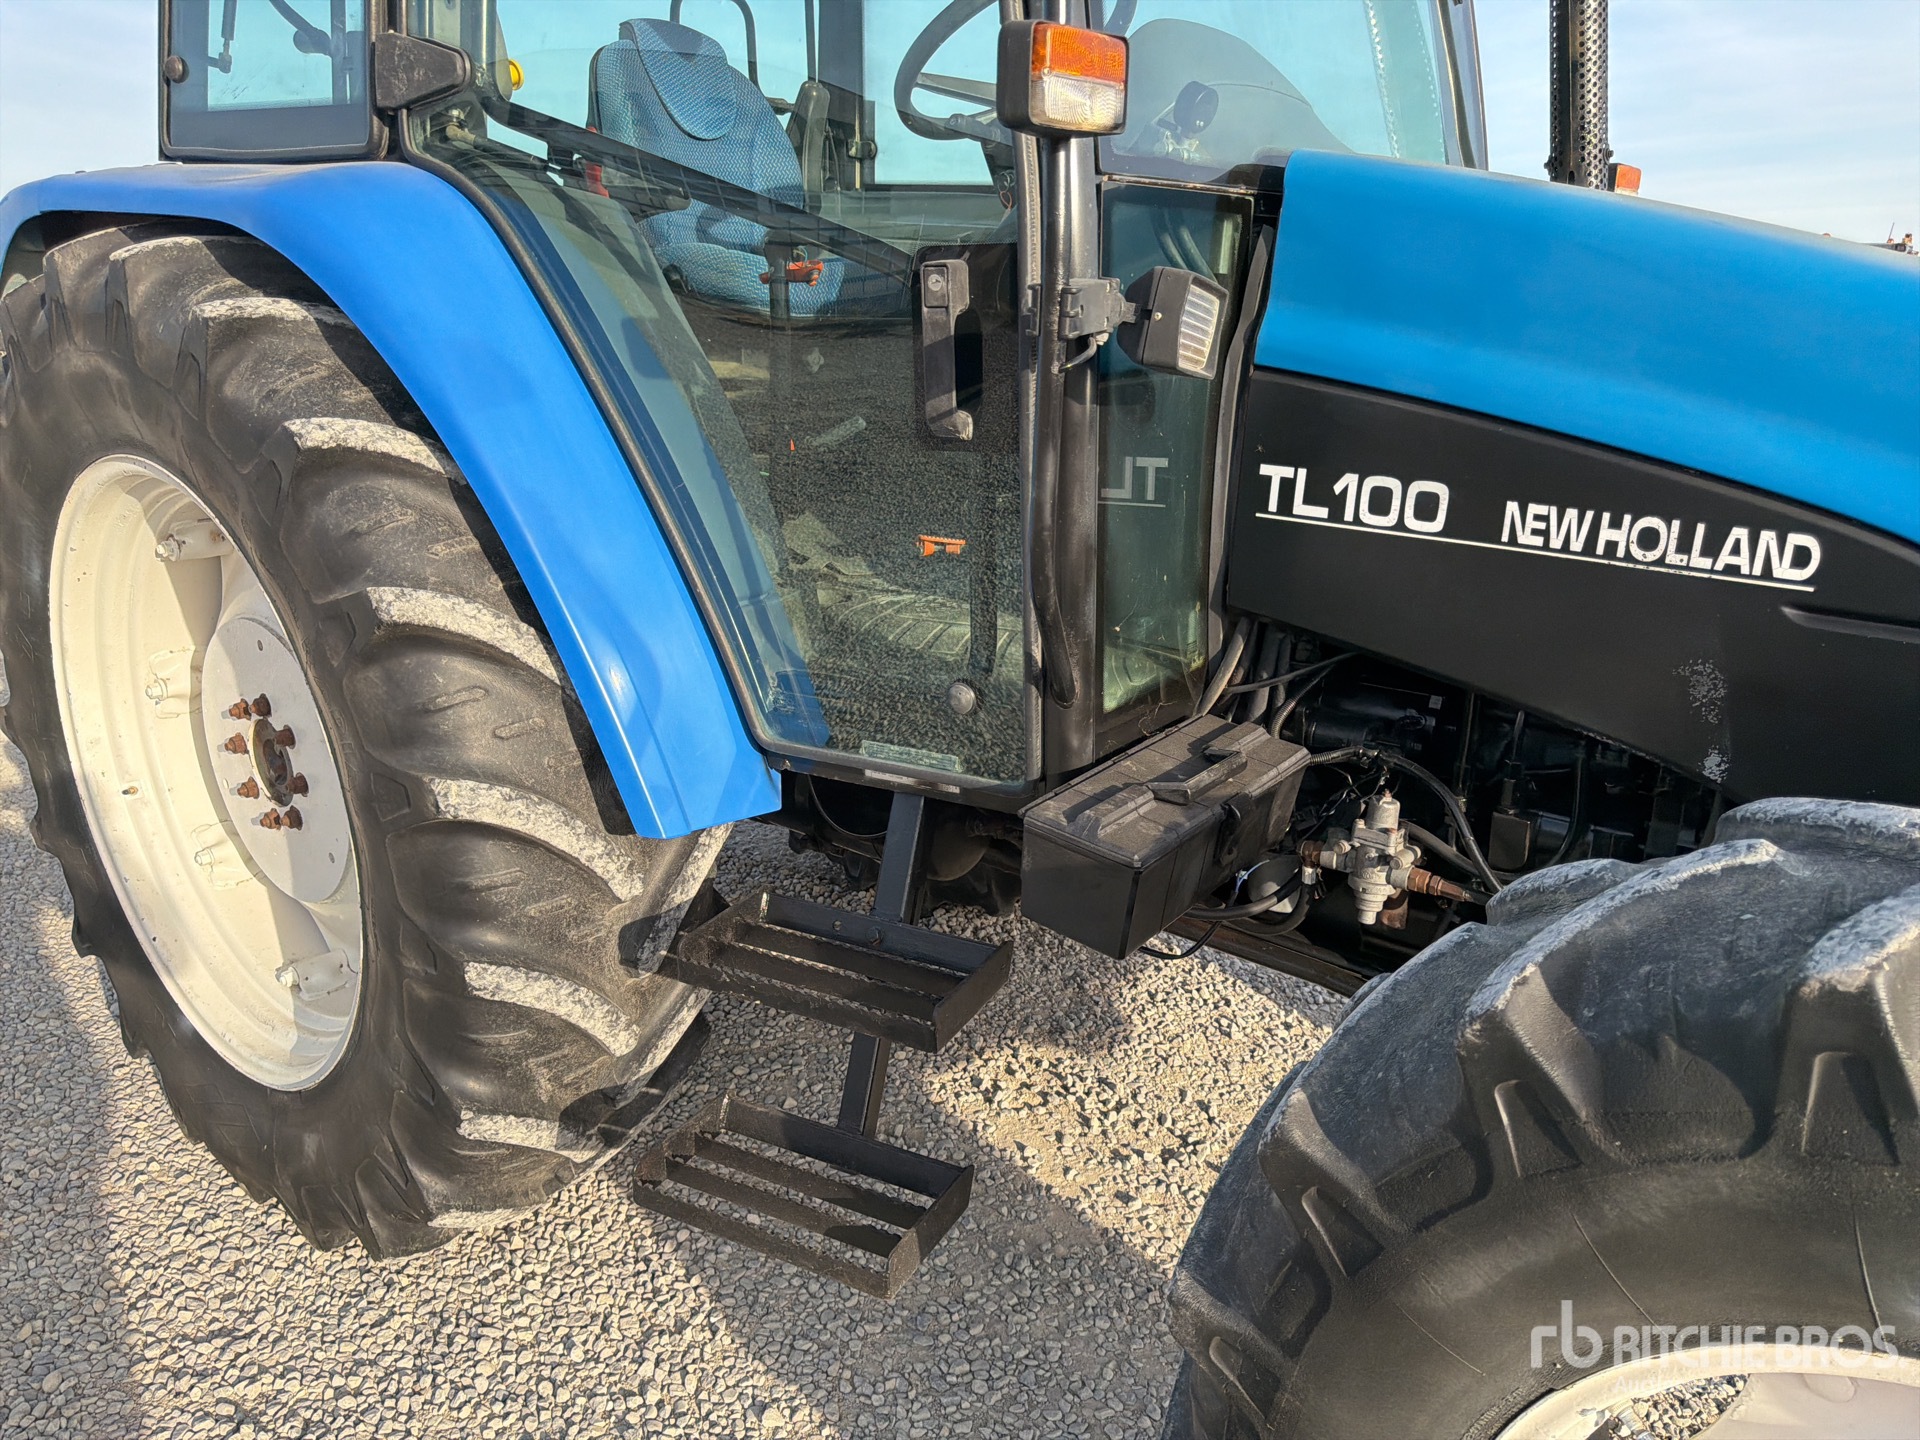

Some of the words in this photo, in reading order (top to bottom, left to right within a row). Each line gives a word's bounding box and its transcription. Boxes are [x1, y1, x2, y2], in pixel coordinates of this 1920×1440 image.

[1259, 463, 1450, 533] TL100
[1501, 500, 1595, 553] NEW
[1595, 511, 1822, 582] HOLLAND
